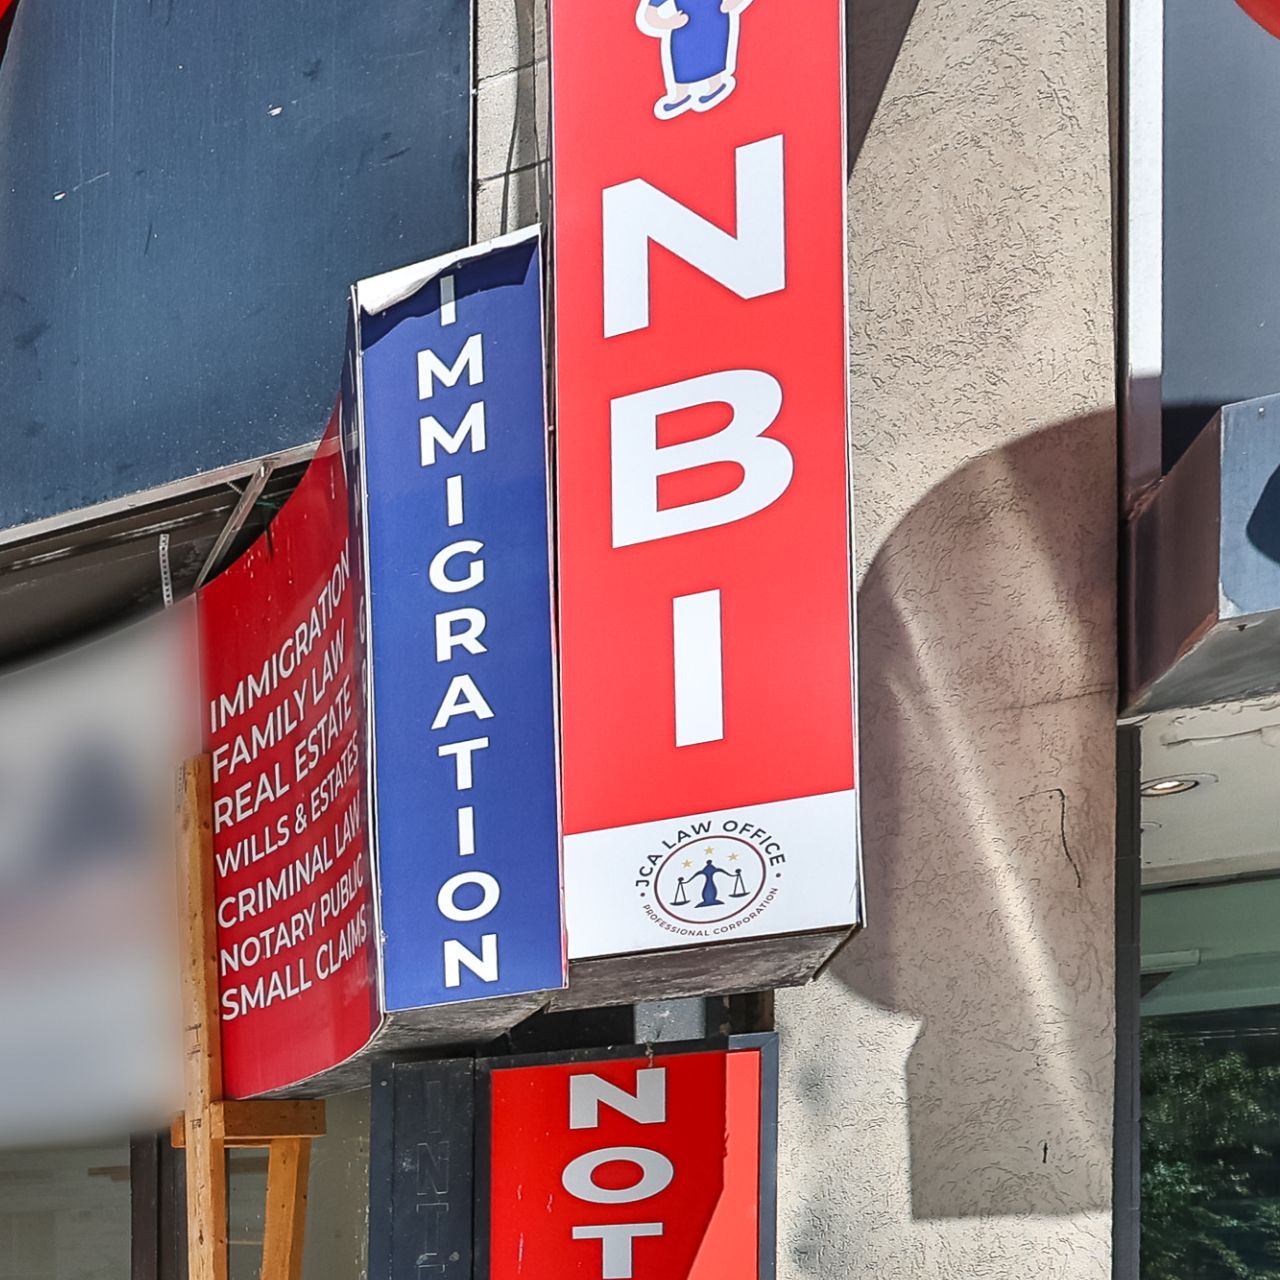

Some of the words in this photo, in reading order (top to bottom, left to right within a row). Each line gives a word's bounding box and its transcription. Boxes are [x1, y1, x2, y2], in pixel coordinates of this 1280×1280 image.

[210, 537, 351, 734] IMMIGRATION
[211, 682, 308, 783] FAMILY
[310, 617, 347, 701] LAW
[417, 275, 501, 989] IMMIGRATION
[213, 762, 290, 834] REAL
[295, 687, 353, 780] ESTATE
[215, 821, 290, 878] WILLS
[294, 807, 308, 835] &
[310, 743, 360, 815] ESTATES
[217, 846, 333, 931] CRIMINAL
[335, 790, 362, 860] LAW
[220, 908, 320, 977] NOTARY
[319, 852, 365, 926] PUBLIC
[635, 853, 663, 888] JCA
[662, 820, 713, 850] LAW
[722, 819, 787, 867] OFFICE
[641, 903, 711, 938] PROFESSIONAL
[712, 887, 780, 935] CORPORATION
[222, 954, 313, 1021] SMALL
[315, 906, 368, 982] CLAIMS
